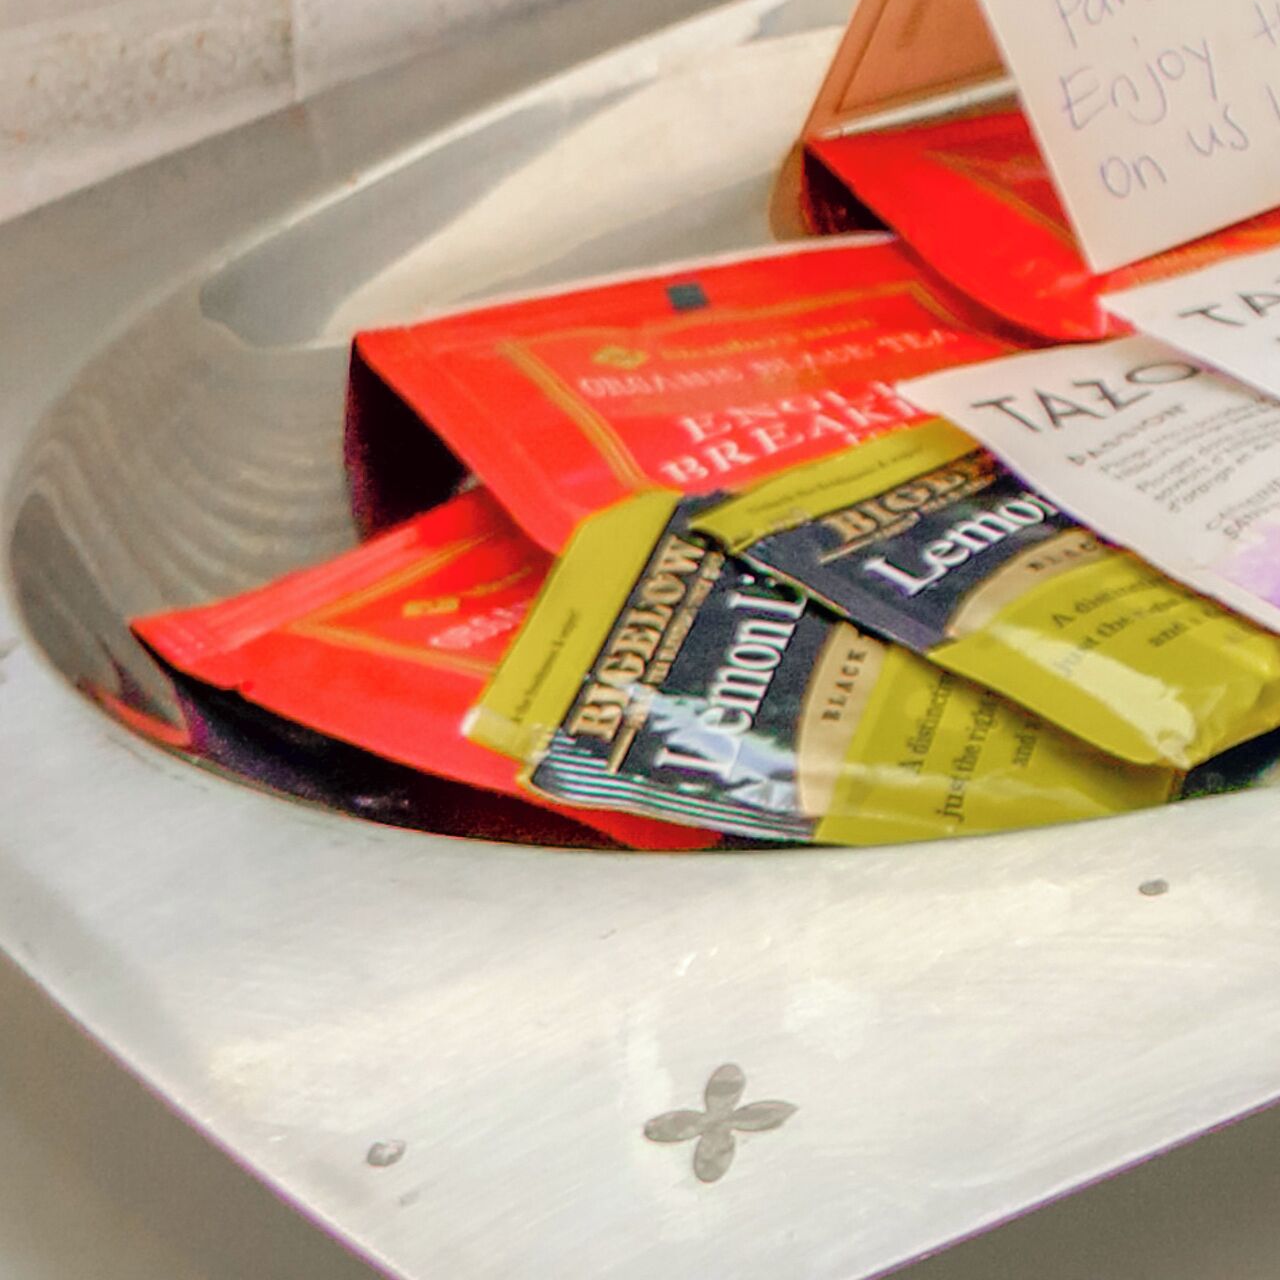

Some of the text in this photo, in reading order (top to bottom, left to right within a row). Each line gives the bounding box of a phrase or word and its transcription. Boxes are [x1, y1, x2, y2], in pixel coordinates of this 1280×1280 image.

[1060, 36, 1218, 131] Enjoy
[1100, 154, 1169, 199] on
[569, 533, 706, 741] BIGELOW
[654, 620, 797, 780] Lemon
[821, 646, 867, 724] BLACK
